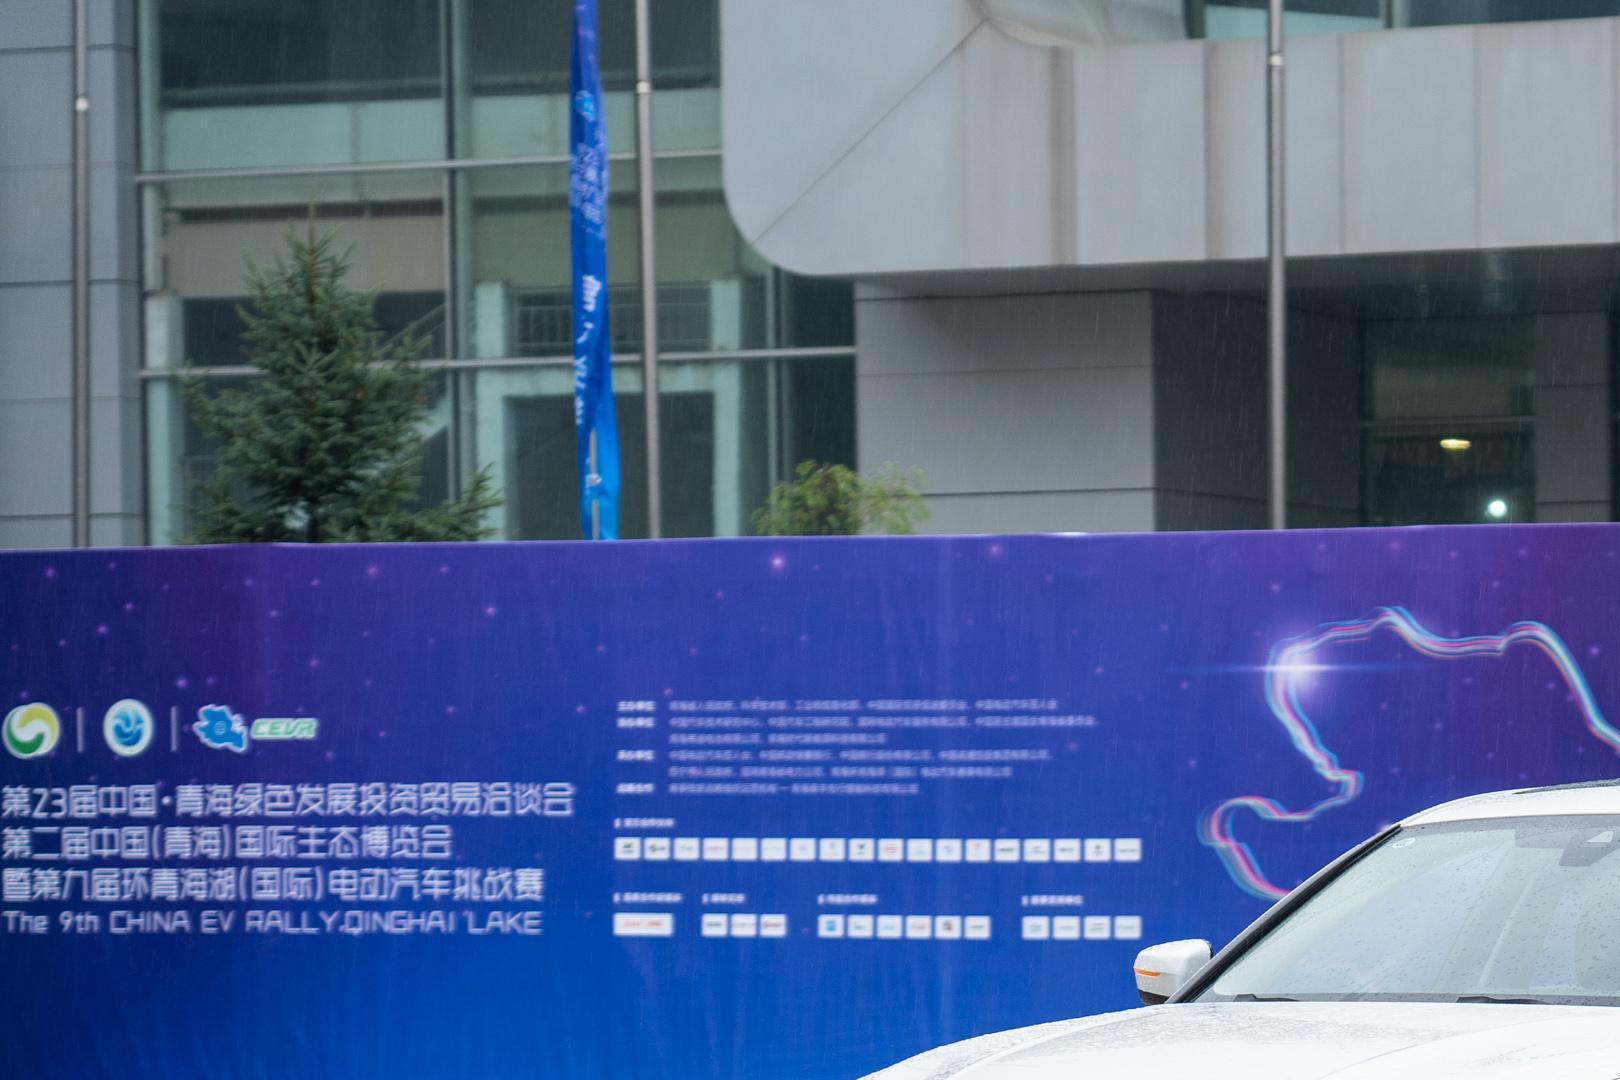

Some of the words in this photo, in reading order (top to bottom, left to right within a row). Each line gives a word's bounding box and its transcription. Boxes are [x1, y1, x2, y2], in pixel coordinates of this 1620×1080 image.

[2, 910, 49, 934] The
[58, 910, 100, 934] 9th
[109, 910, 191, 934] CHINA
[201, 910, 236, 934] EV
[466, 909, 544, 935] LAKE
